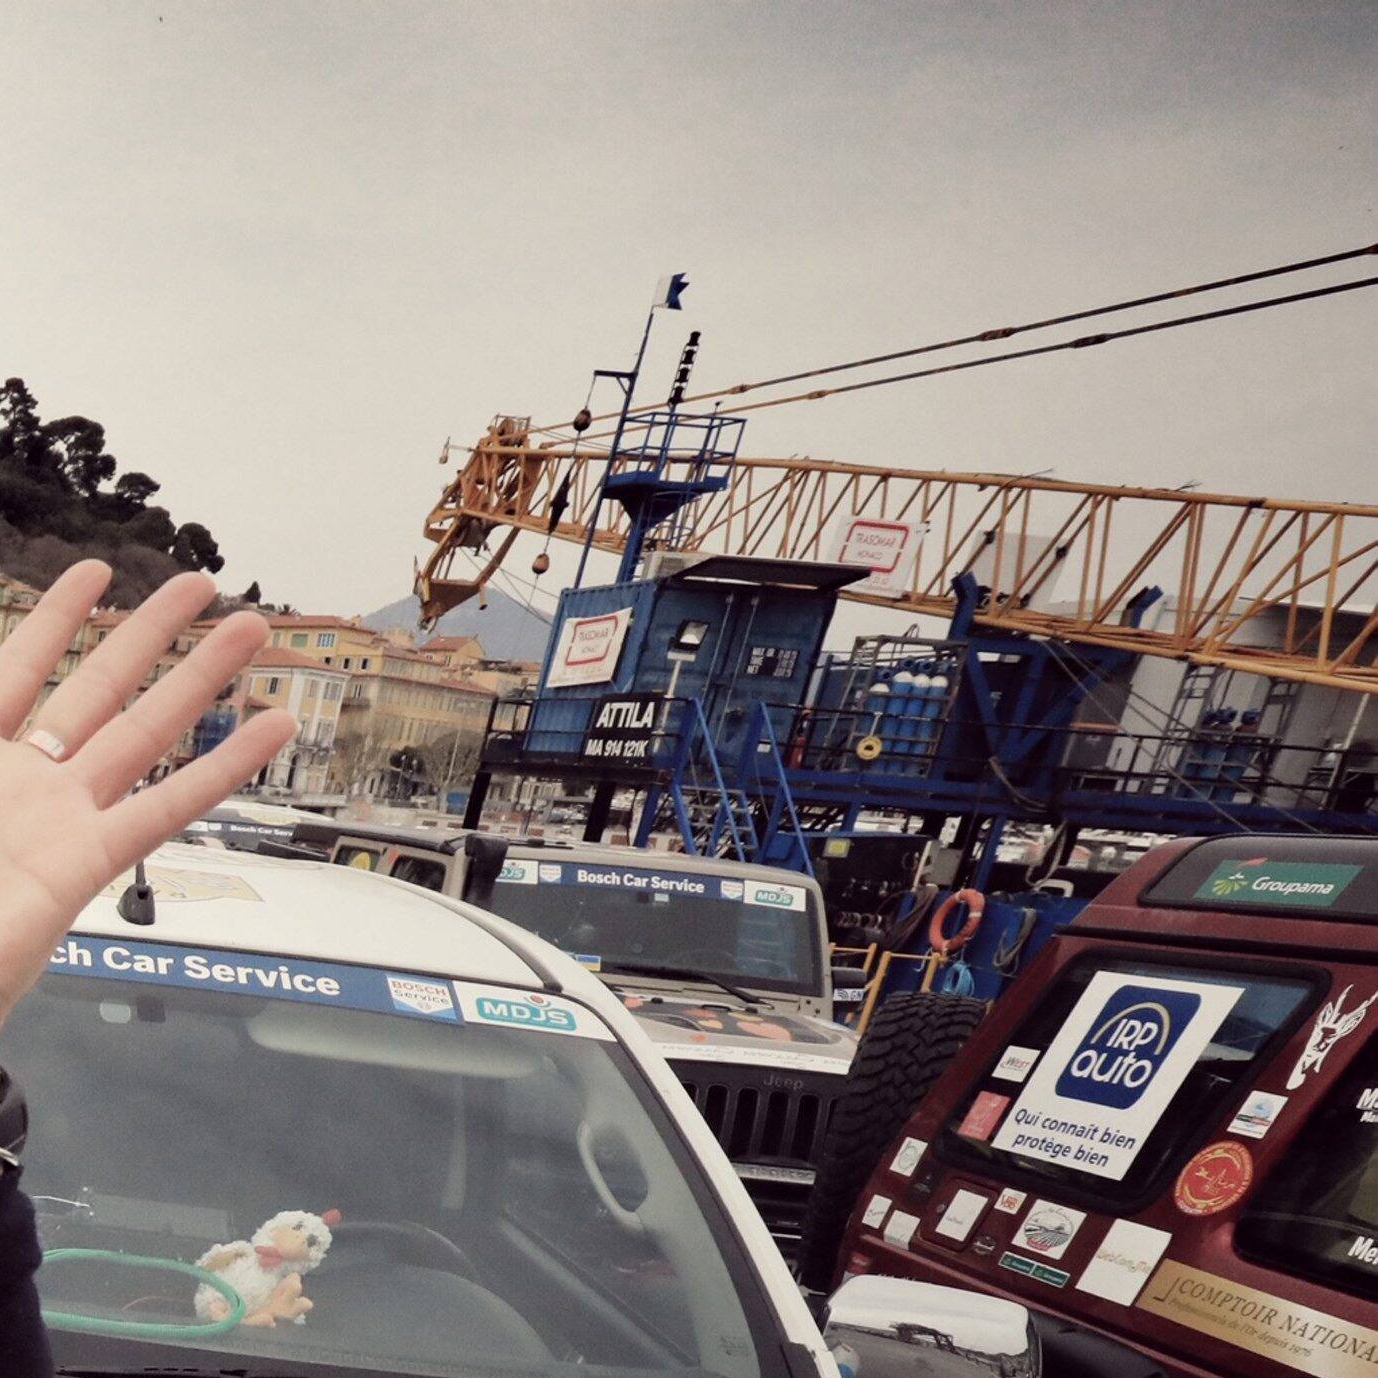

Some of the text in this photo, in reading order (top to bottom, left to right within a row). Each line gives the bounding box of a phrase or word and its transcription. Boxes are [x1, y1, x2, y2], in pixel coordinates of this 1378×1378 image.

[595, 702, 656, 729] ATTILA
[584, 739, 602, 756] MA
[603, 739, 622, 757] 914
[577, 870, 705, 894] Bosch Car Service
[1251, 875, 1335, 897] Groupama
[103, 946, 174, 977] Car
[184, 956, 341, 997] Service
[392, 980, 446, 998] BOSCH
[393, 989, 451, 1007] Service
[483, 1001, 570, 1027] MDJS
[1107, 1015, 1159, 1053] IRP
[1069, 1048, 1153, 1090] auto
[763, 1074, 805, 1091] Jeep
[1014, 1108, 1137, 1150] Qui connaît bien
[1012, 1132, 1109, 1168] protège bien
[1179, 1278, 1278, 1326] COMPTOIR
